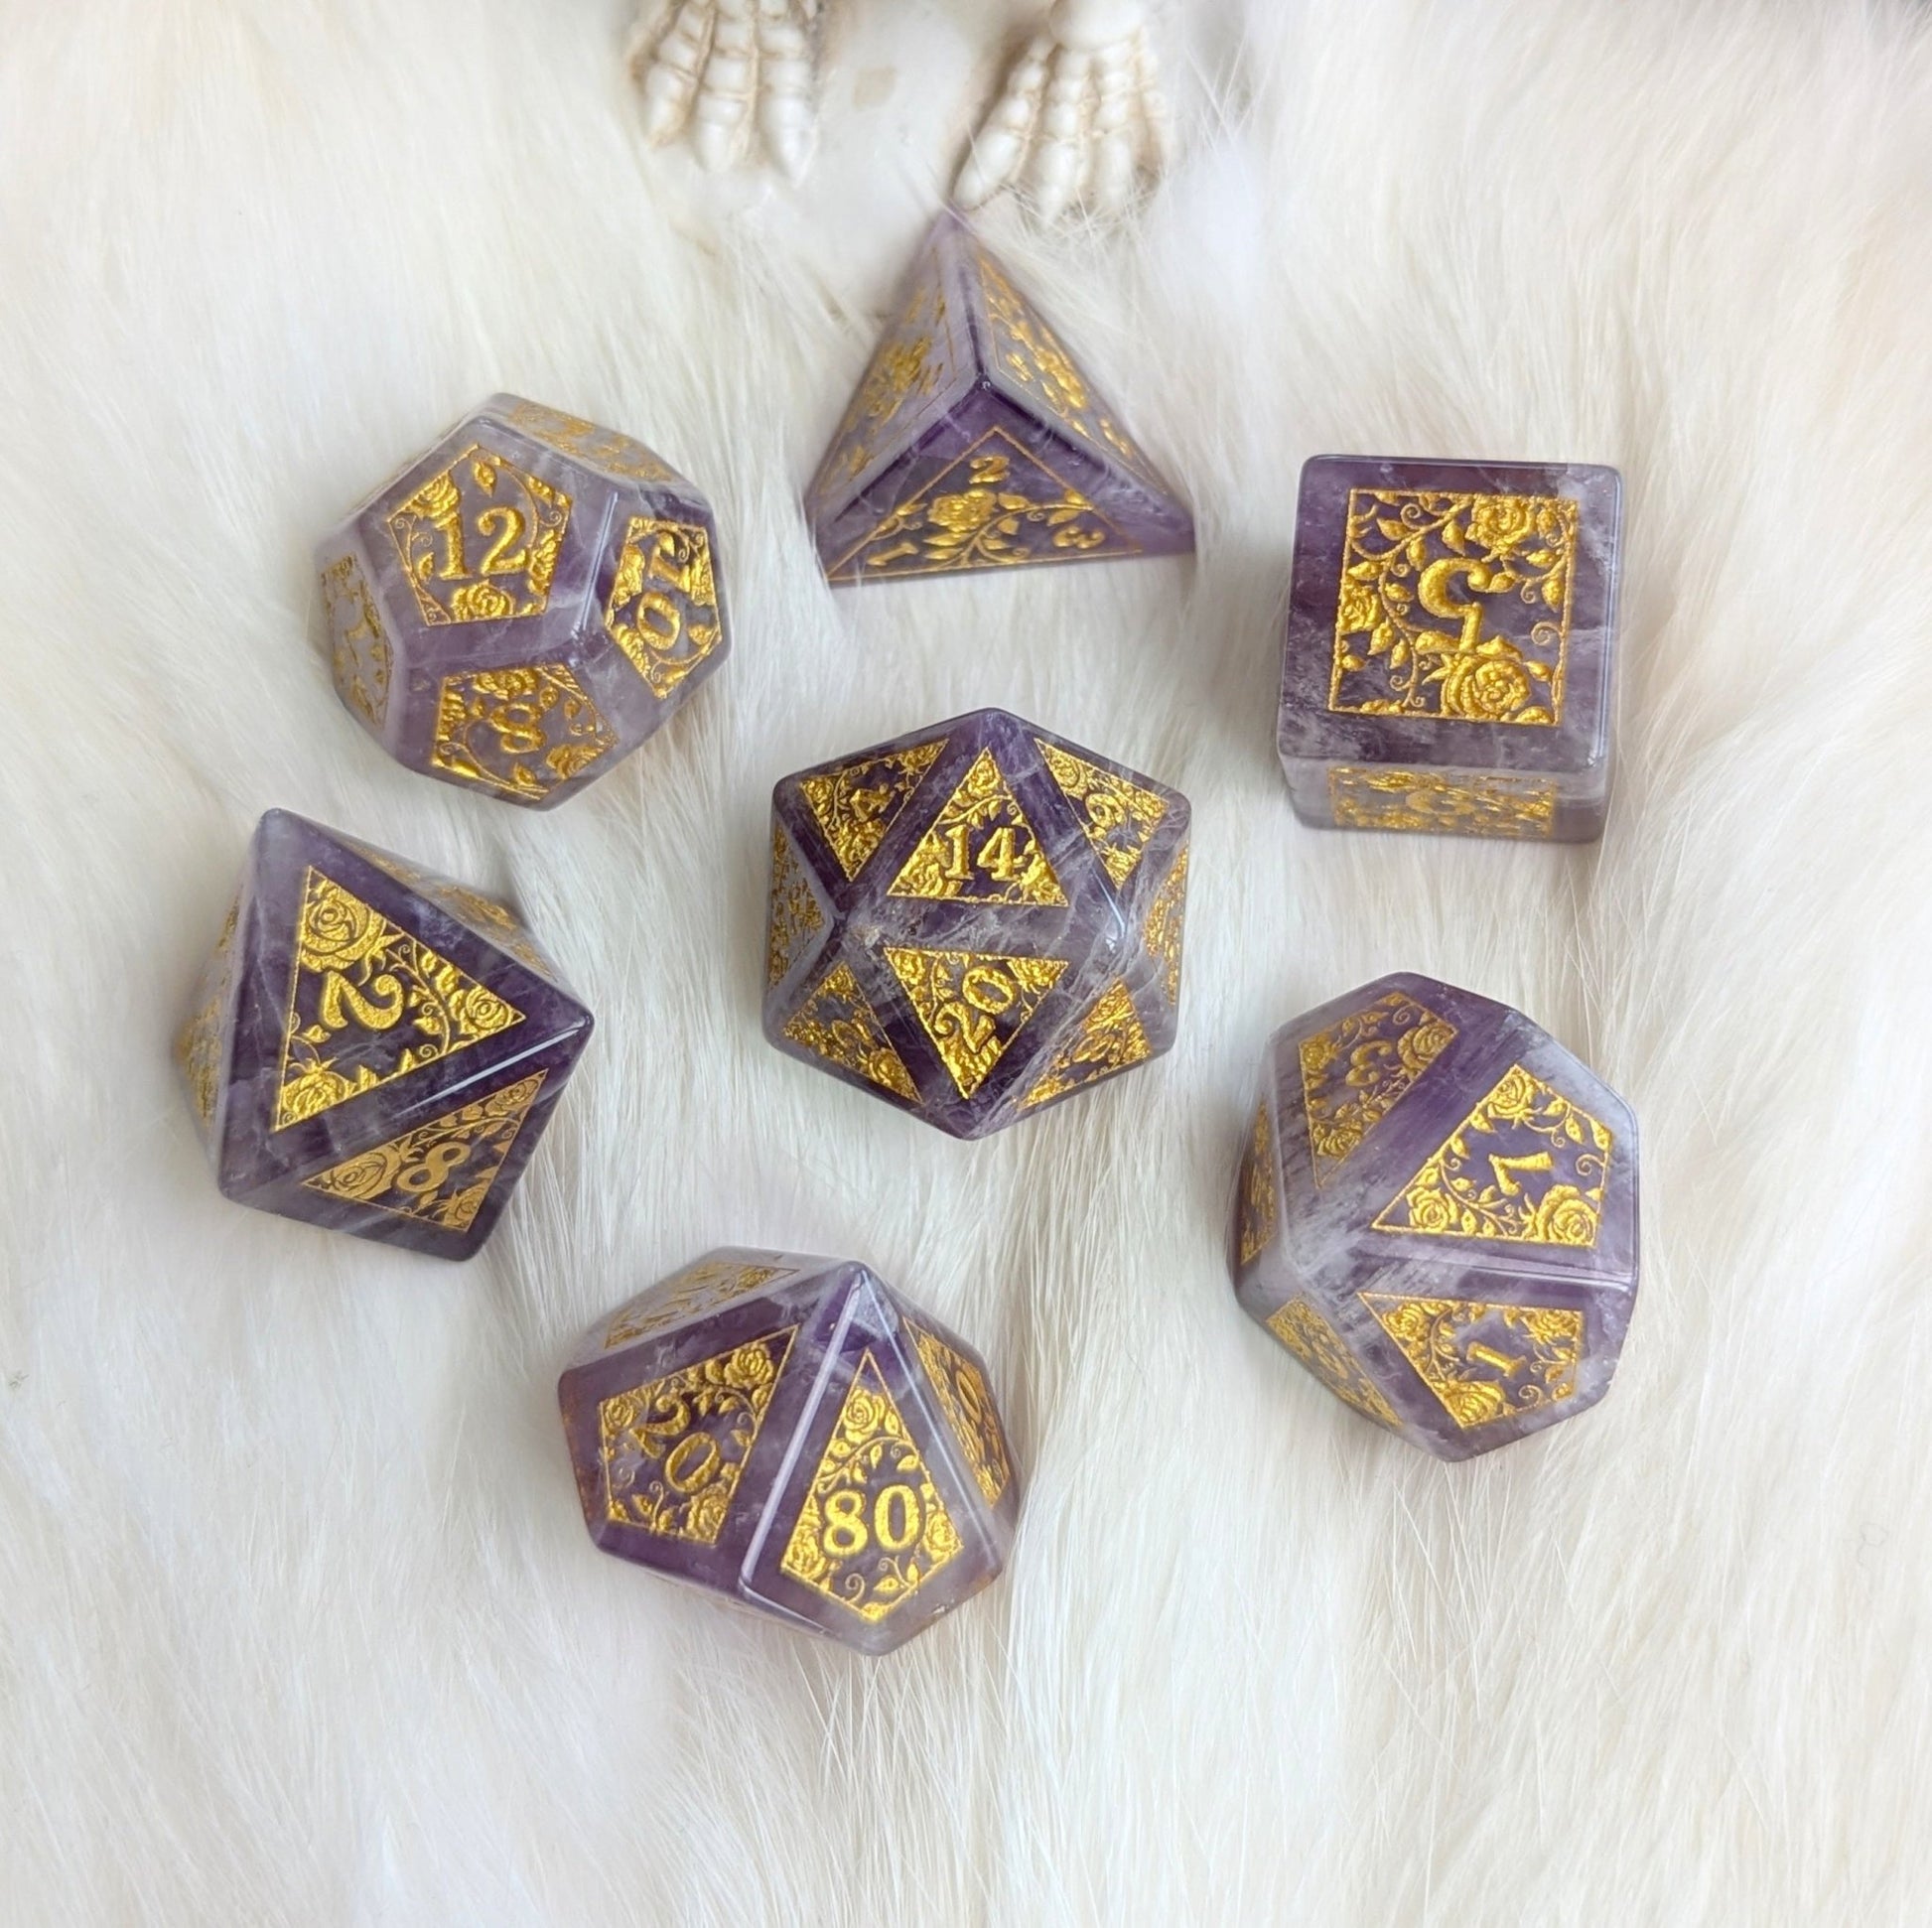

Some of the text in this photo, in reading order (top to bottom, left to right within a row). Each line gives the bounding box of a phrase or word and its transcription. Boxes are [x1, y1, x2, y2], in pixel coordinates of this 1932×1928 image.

[968, 455, 1011, 484] 2
[435, 504, 532, 581] 12
[1052, 526, 1106, 550] 3
[637, 547, 691, 651] 10
[1416, 557, 1491, 655] 5
[486, 703, 546, 755] 8
[944, 826, 1027, 881] 14
[320, 970, 403, 1030] 2
[934, 965, 1017, 1054] 20
[1345, 1039, 1391, 1087] 3
[397, 1141, 472, 1192] 8
[1488, 1152, 1554, 1195] 7
[1466, 1342, 1527, 1377] 1
[629, 1392, 722, 1493] 20
[823, 1484, 926, 1556] 80
